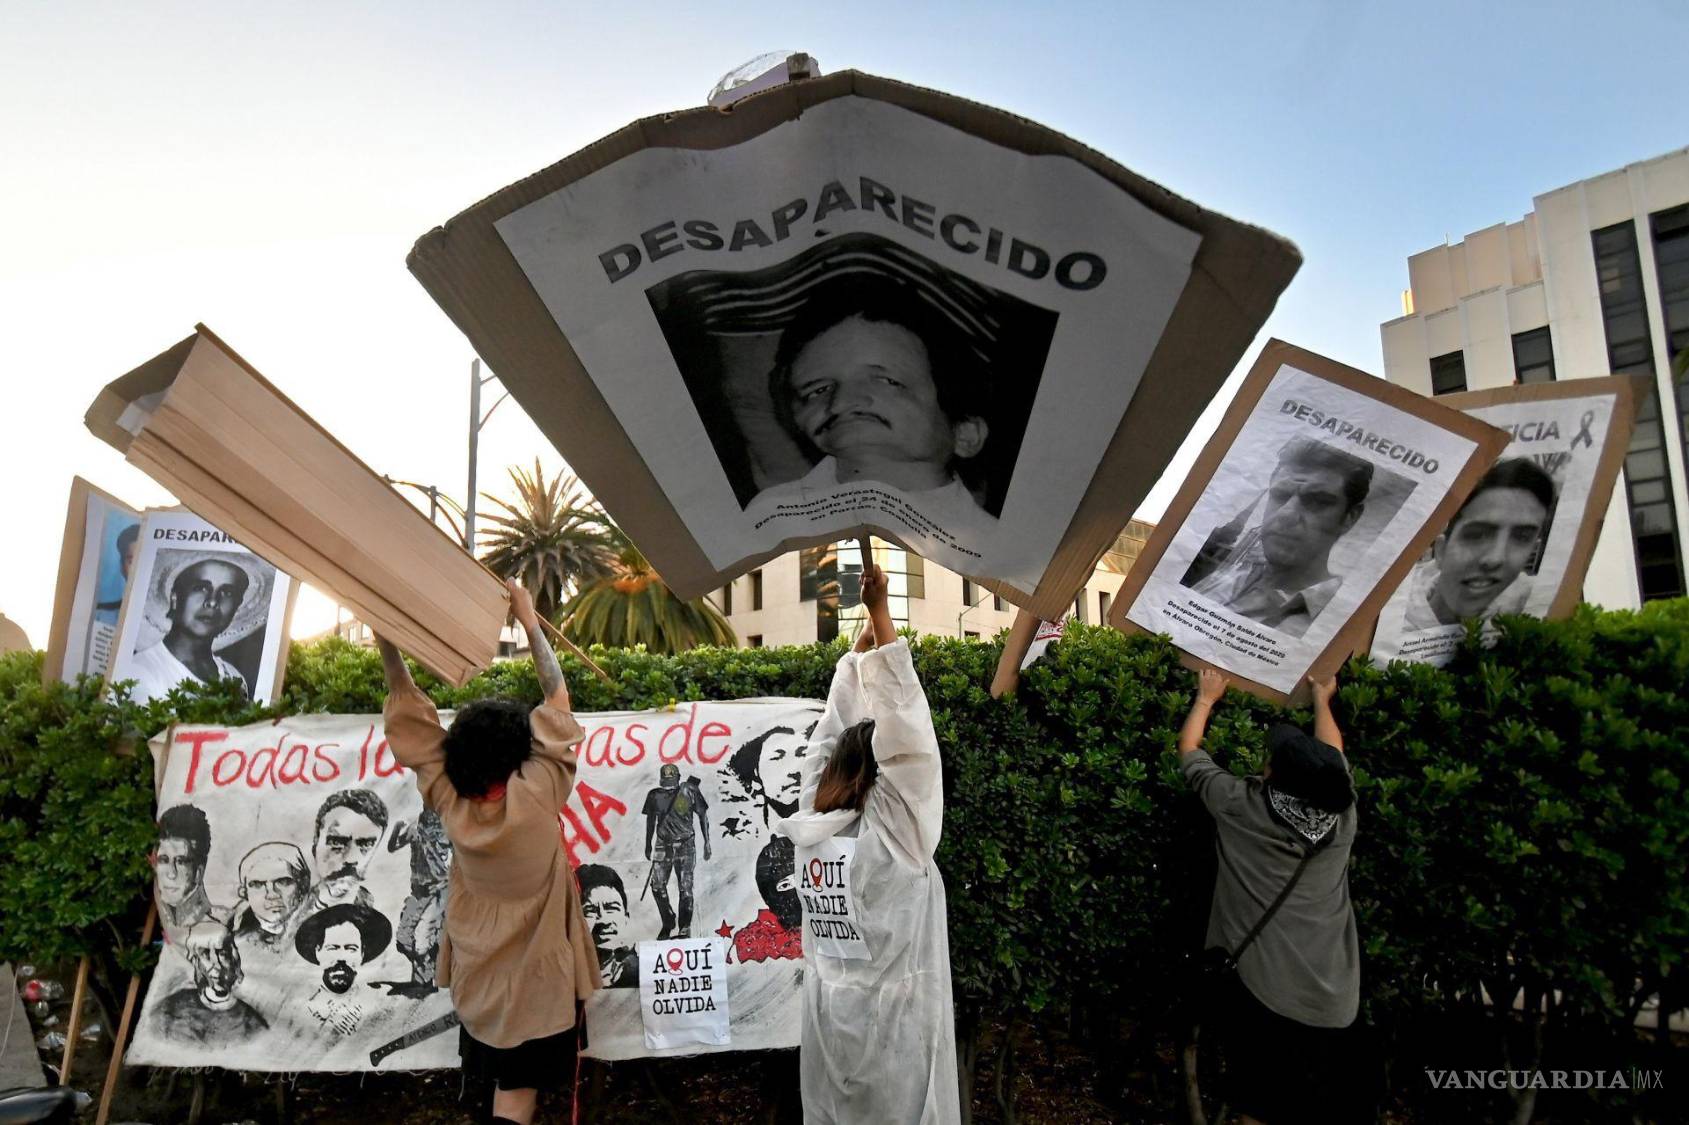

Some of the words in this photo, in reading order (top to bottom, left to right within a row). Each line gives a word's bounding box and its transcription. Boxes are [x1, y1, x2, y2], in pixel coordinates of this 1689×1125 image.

[598, 176, 1108, 291] DESAPARECIDO
[1279, 399, 1439, 474] DESAPARECIDO
[1503, 421, 1560, 442] ICIA
[776, 498, 827, 510] Antonio
[755, 502, 841, 530] Desaparecido
[881, 500, 895, 509] de
[153, 528, 238, 544] DESAPAR
[1188, 600, 1209, 614] Edgar
[1167, 600, 1212, 627] Desaparecido
[1226, 630, 1236, 639] de
[1236, 636, 1259, 648] agosto
[1259, 643, 1270, 652] del
[1224, 640, 1248, 654] Ciudad
[174, 730, 341, 795] Todas
[357, 720, 405, 781] la
[575, 723, 649, 769] as
[658, 703, 732, 766] de
[558, 780, 627, 872] HA
[803, 895, 848, 916] NADIE
[810, 918, 860, 941] OLVIDA
[653, 974, 713, 995] NADIE
[652, 995, 717, 1016] OLVIDA
